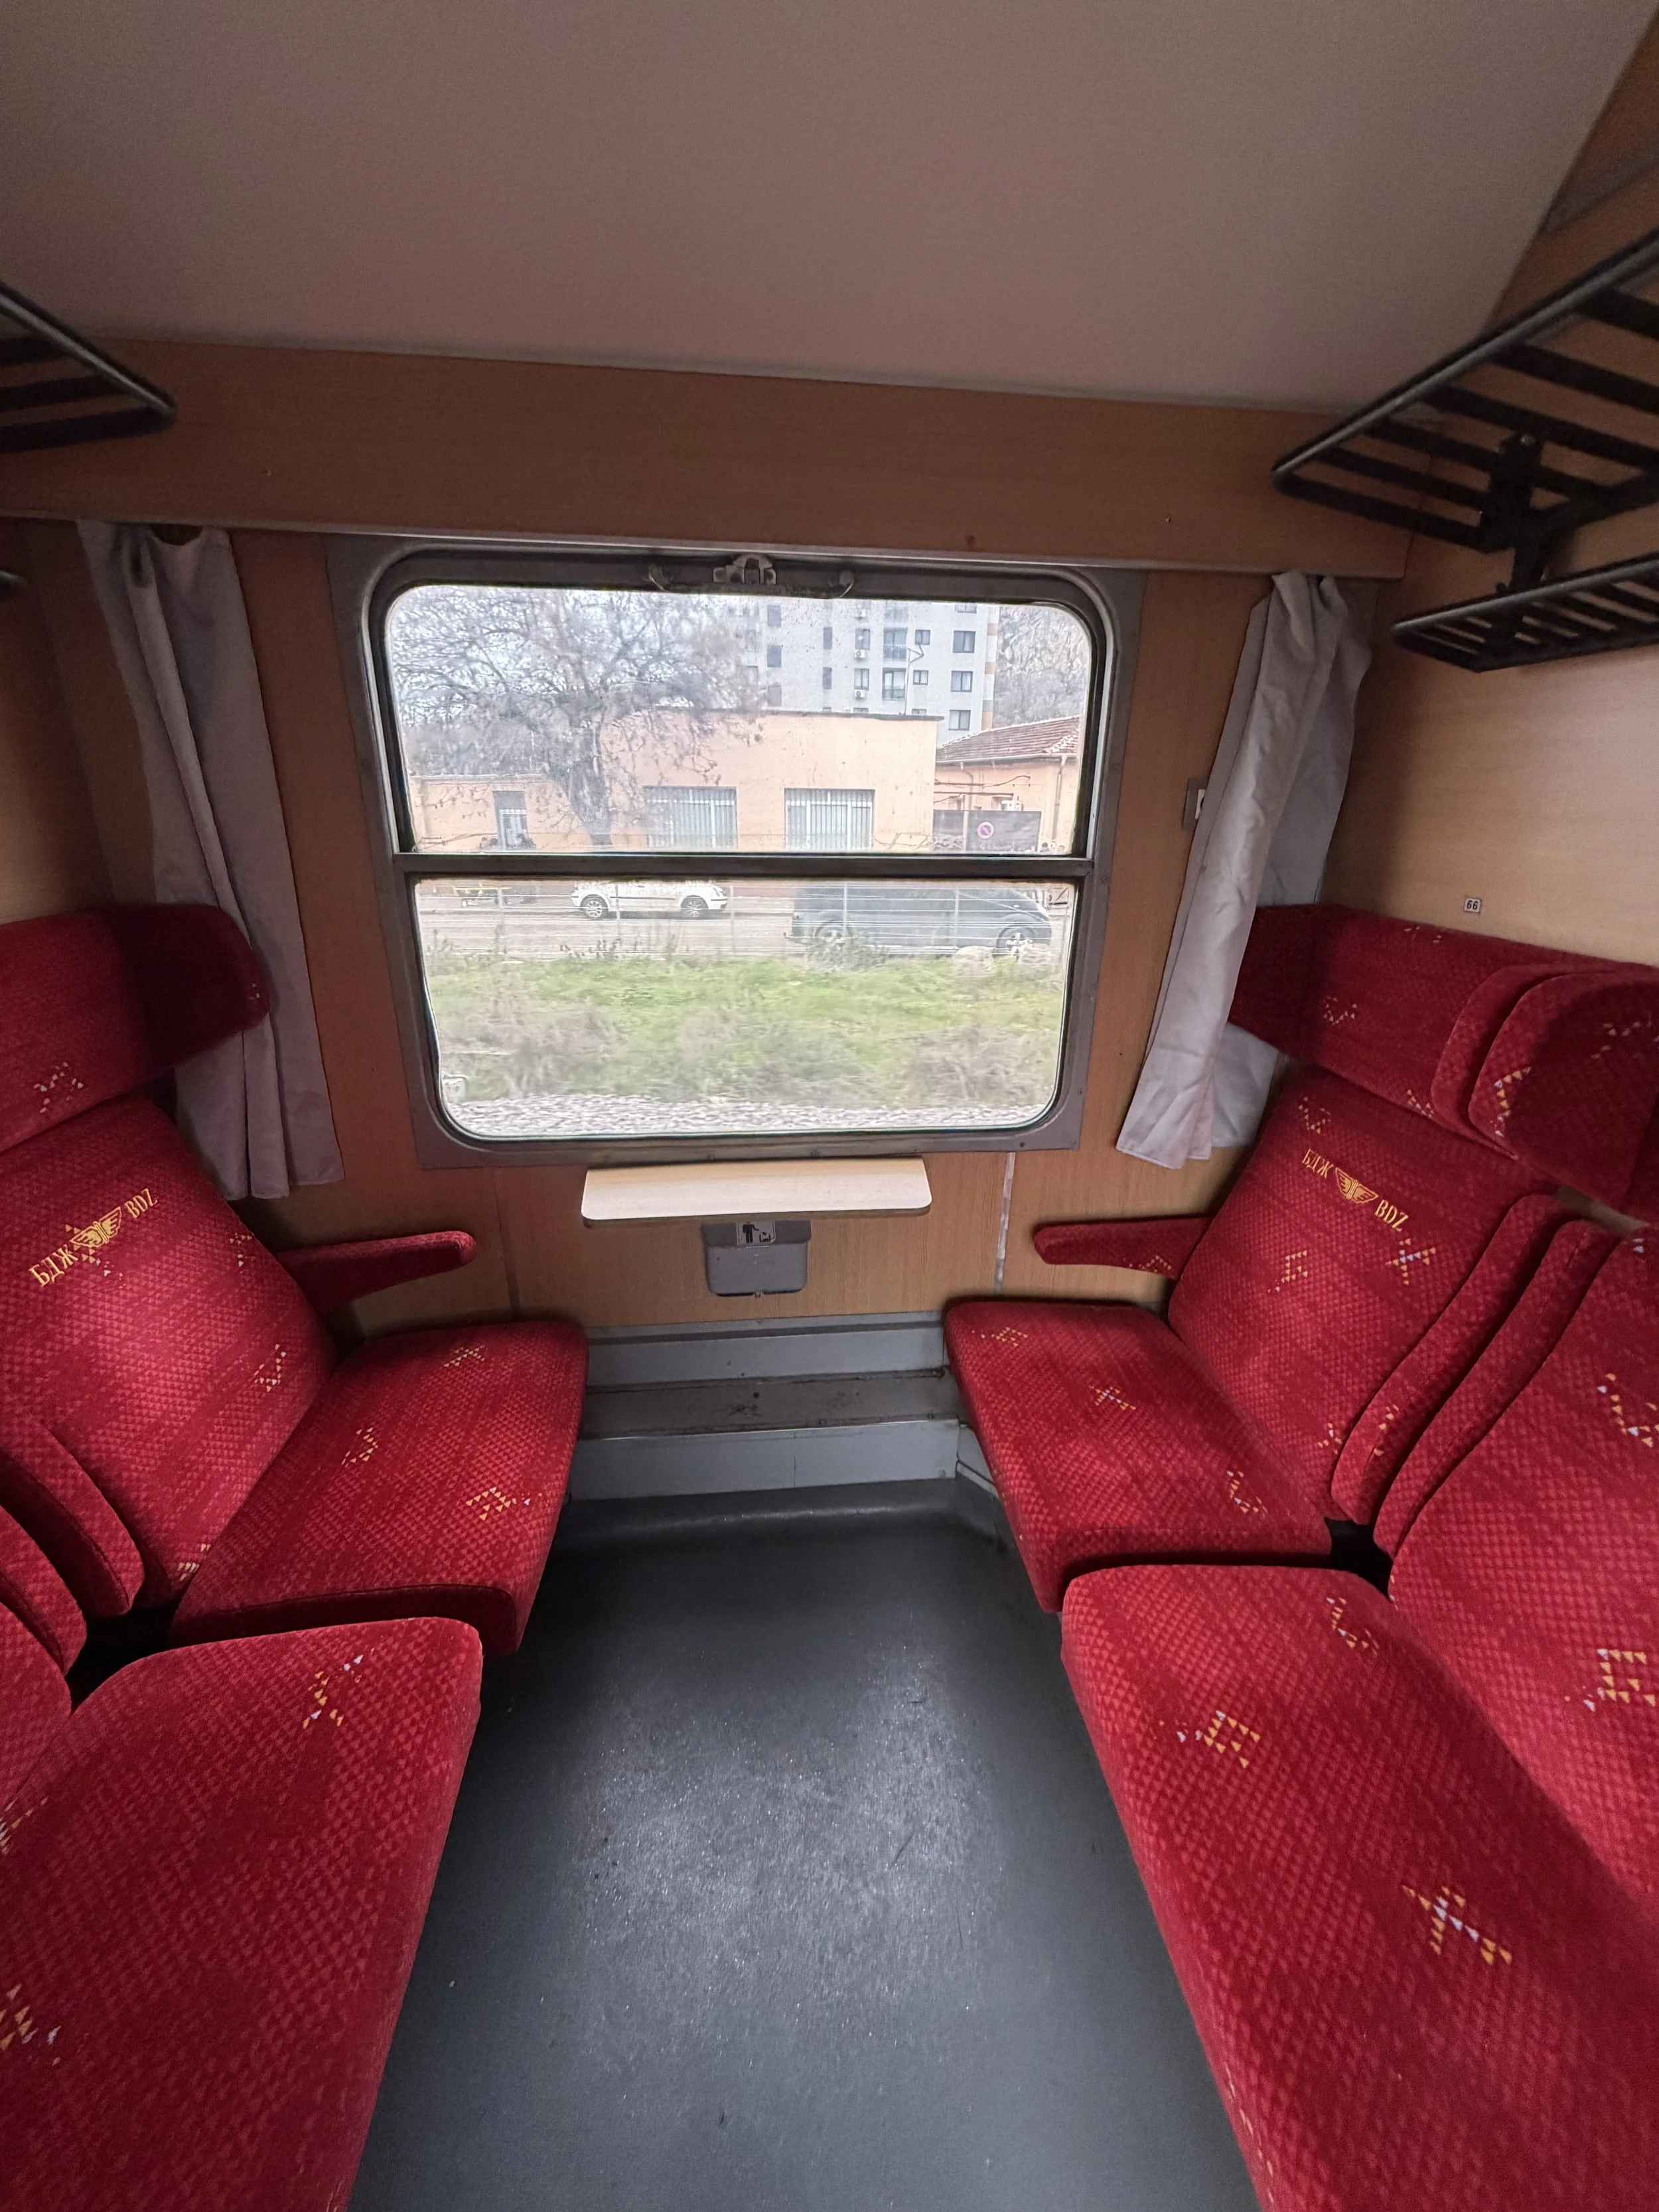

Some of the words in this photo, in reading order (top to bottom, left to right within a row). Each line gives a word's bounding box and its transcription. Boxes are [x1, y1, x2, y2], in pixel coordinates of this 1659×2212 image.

[1467, 900, 1479, 910] 66
[1301, 1149, 1334, 1179] БДЖ
[1374, 1199, 1409, 1232] BDZ
[29, 1244, 78, 1287] БДЖ
[124, 1188, 158, 1218] BDZ
